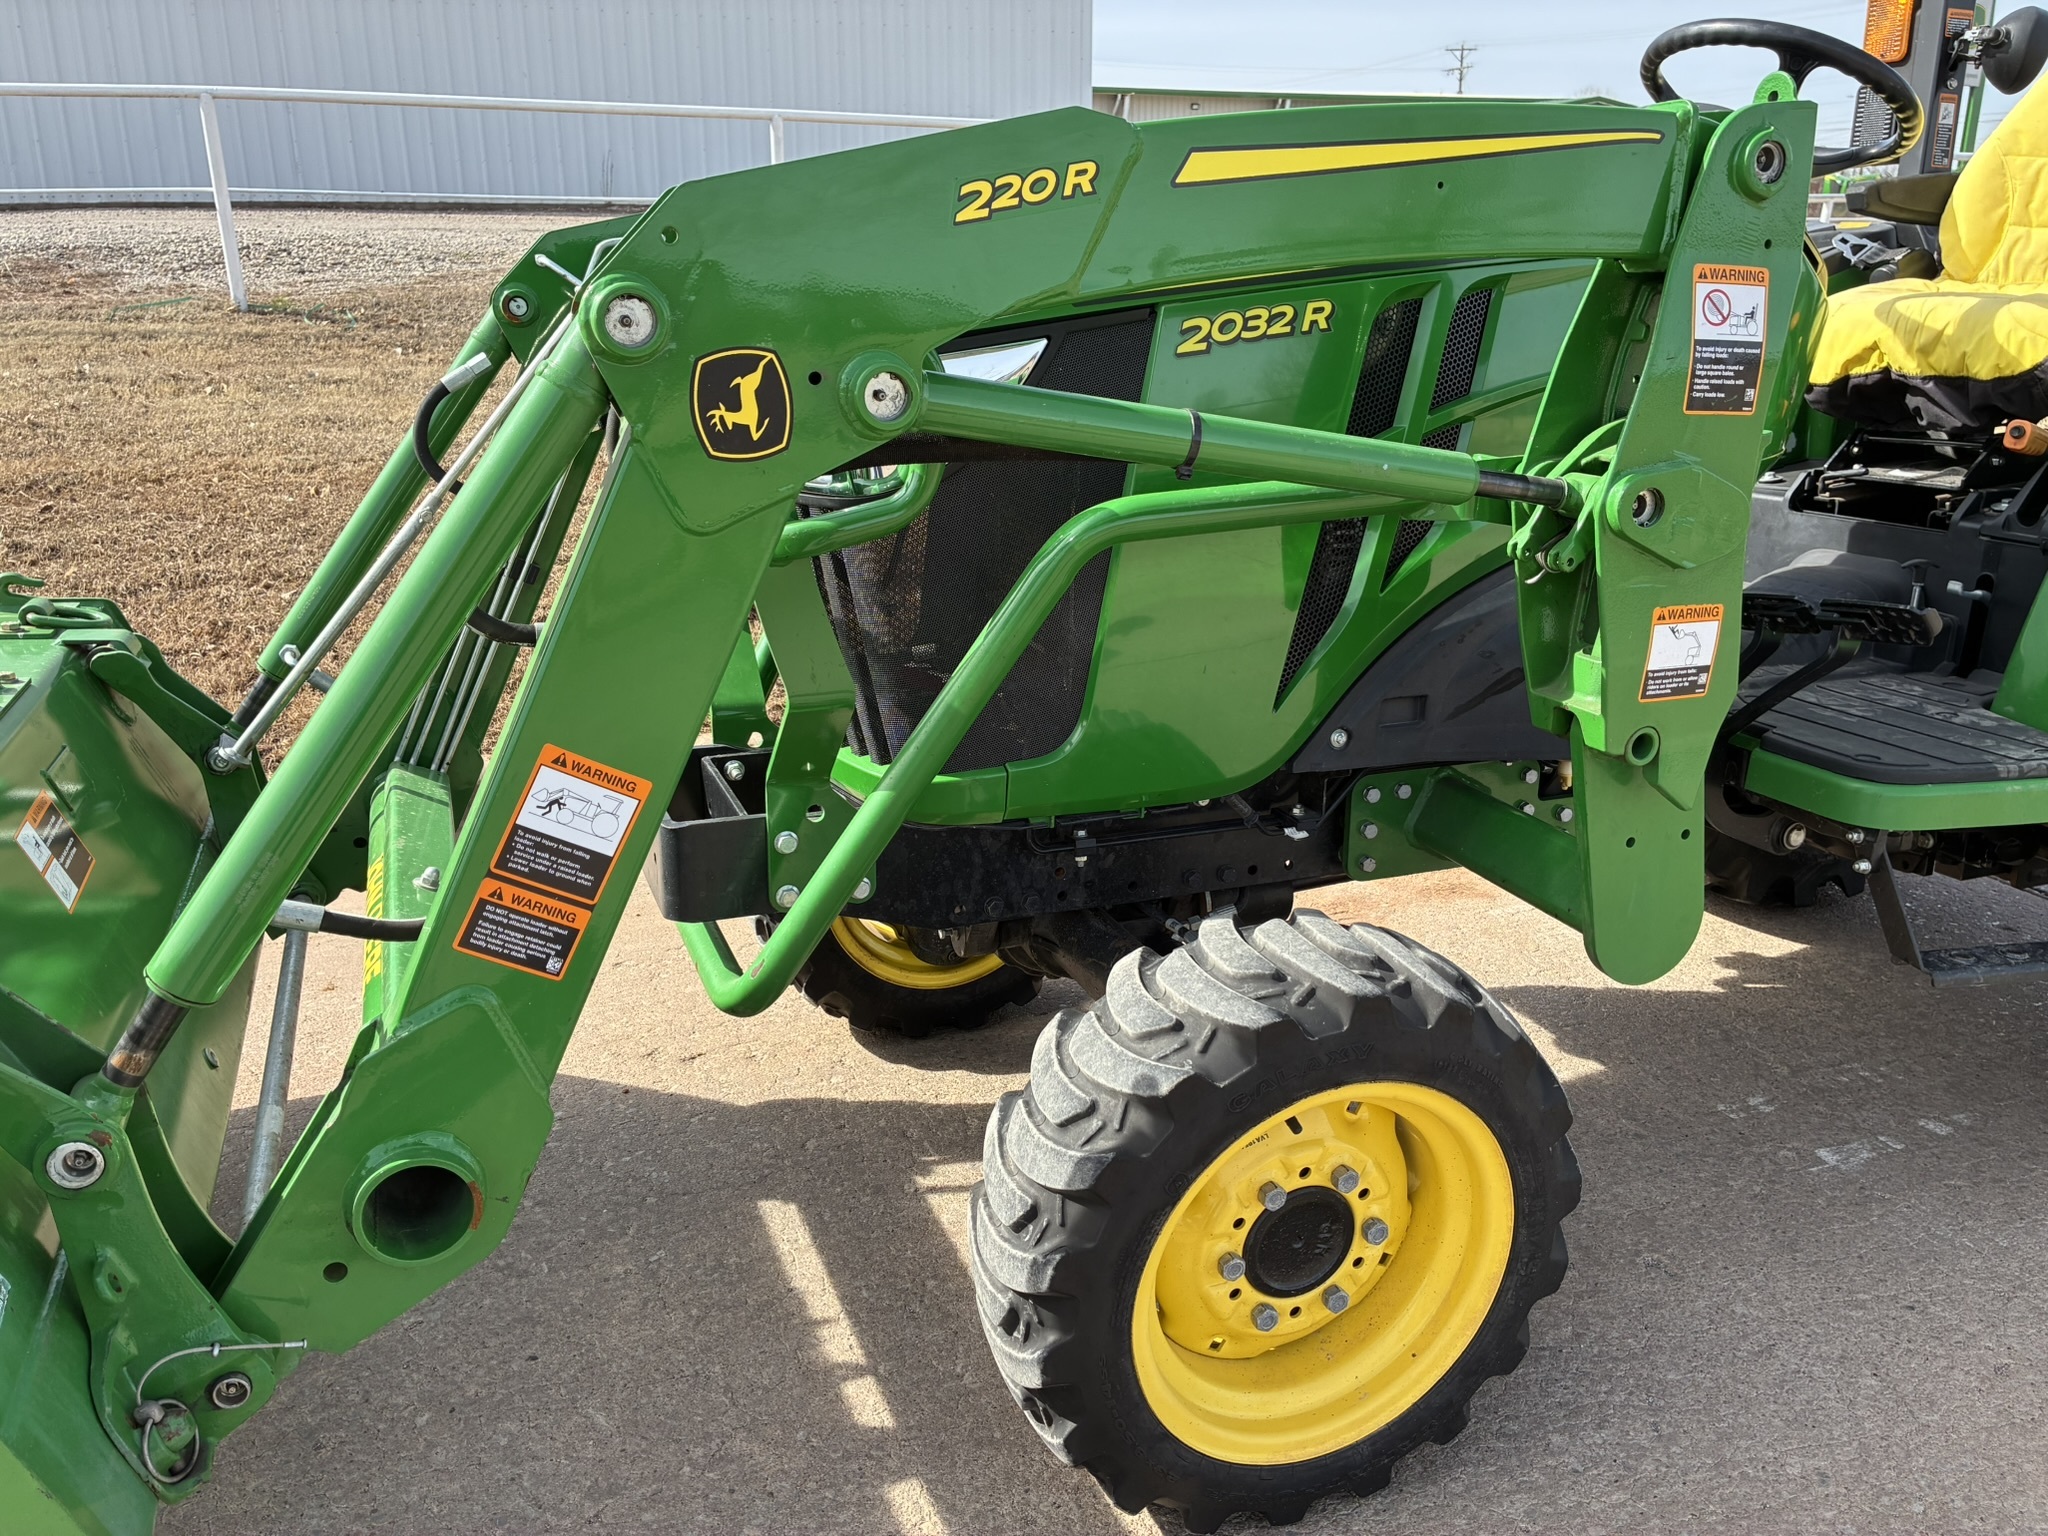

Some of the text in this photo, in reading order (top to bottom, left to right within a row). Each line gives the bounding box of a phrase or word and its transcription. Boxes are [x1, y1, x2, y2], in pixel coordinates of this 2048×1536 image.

[1710, 268, 1765, 282] WARNING
[1668, 606, 1719, 620] WARNING
[571, 760, 637, 793] WARNING
[514, 836, 535, 845] loader:
[525, 833, 541, 841] avoid
[542, 839, 558, 848] injury
[573, 850, 591, 858] falling
[508, 862, 530, 872] parked.
[511, 856, 529, 864] Lower
[530, 862, 548, 871] loader
[556, 871, 576, 881] ground
[577, 878, 592, 886] when
[514, 850, 535, 860] service
[536, 857, 552, 865] under
[558, 865, 576, 873] raised
[577, 871, 595, 880] loader.
[558, 858, 581, 869] perform
[511, 893, 576, 923] WARNING
[479, 920, 497, 929] Failure
[504, 929, 525, 939] engage
[526, 935, 546, 944] retainer
[547, 942, 562, 950] could
[483, 911, 555, 937] engaging attachment latch.
[509, 913, 530, 923] operate
[531, 919, 547, 928] loader
[549, 925, 568, 934] without
[470, 938, 487, 947] bodily
[487, 943, 504, 952] injury
[511, 951, 528, 959] death.
[476, 926, 492, 934] result
[498, 933, 529, 946] attachment
[530, 943, 556, 955] detaching
[487, 936, 504, 945] loader
[505, 942, 526, 952] causing
[527, 949, 547, 958] serious
[1228, 1041, 1375, 1113] GALAXY
[1476, 1064, 1504, 1088] RATING
